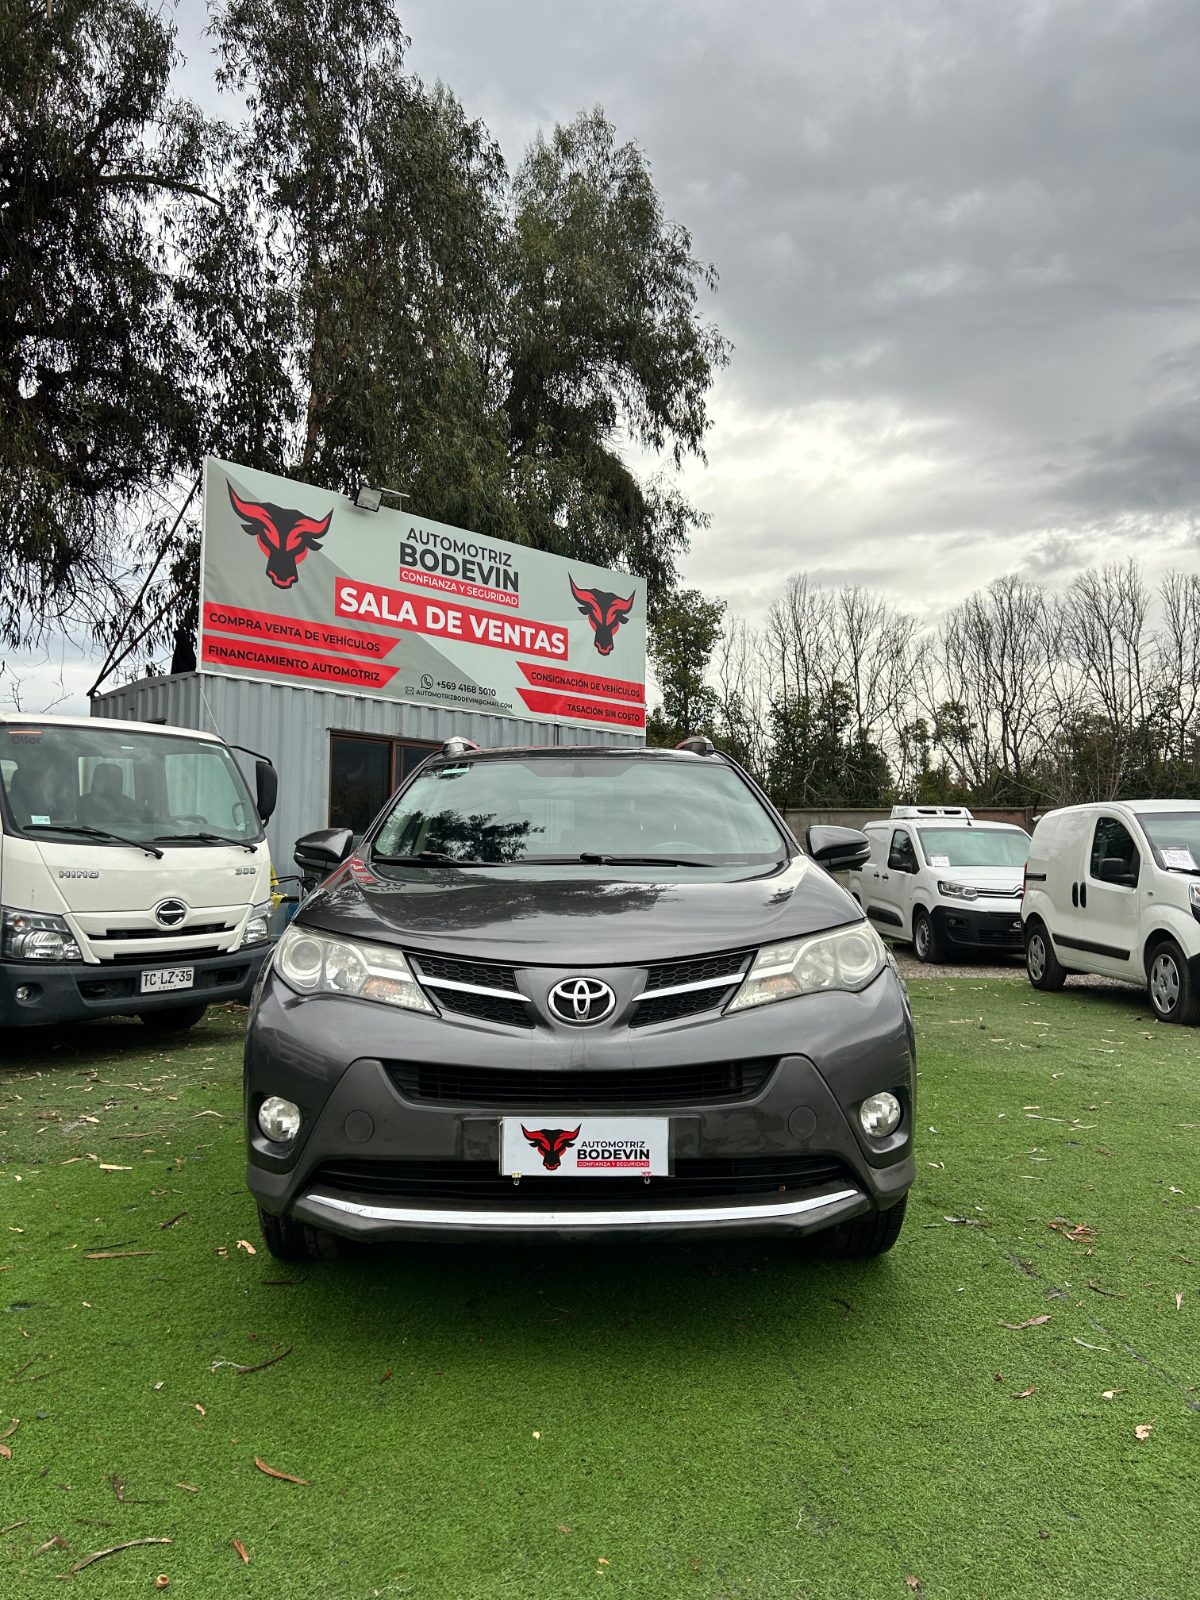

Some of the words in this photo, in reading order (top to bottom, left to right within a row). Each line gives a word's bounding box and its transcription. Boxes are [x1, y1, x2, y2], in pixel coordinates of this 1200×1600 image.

[406, 527, 512, 567] AUTOMOTRIZ
[400, 542, 518, 592] BODEVIN
[401, 570, 458, 592] CONFIANZA
[460, 583, 466, 593] Y
[467, 586, 518, 605] SEGURIDAD
[209, 612, 262, 632] COMPRA
[264, 622, 301, 638] VENTA
[304, 630, 320, 641] DE
[321, 633, 381, 652] VEHÍCULOS
[340, 587, 418, 626] SALA
[426, 605, 463, 635] DE
[469, 615, 566, 655] VENTAS
[208, 645, 309, 670] FINANCIAMIENTO
[311, 662, 381, 682] AUTOMOTRIZ
[436, 681, 457, 691] +569
[458, 684, 477, 694] 4168
[478, 687, 497, 697] 5010
[531, 671, 588, 688] CONSIGNACIÓN
[590, 681, 601, 691] DE
[602, 684, 640, 698] VEHÍCULOS
[416, 689, 513, 710] AUTOMOTRIZBODEVIN@GMAIL.COM
[567, 703, 603, 717] TASACIÓN
[604, 709, 617, 718] SIN
[618, 711, 640, 722] COSTO
[59, 870, 99, 879] HINO
[235, 867, 256, 876] 300
[577, 1149, 650, 1160] BODEVIN
[581, 1140, 646, 1149] AUTOMOTRIZ
